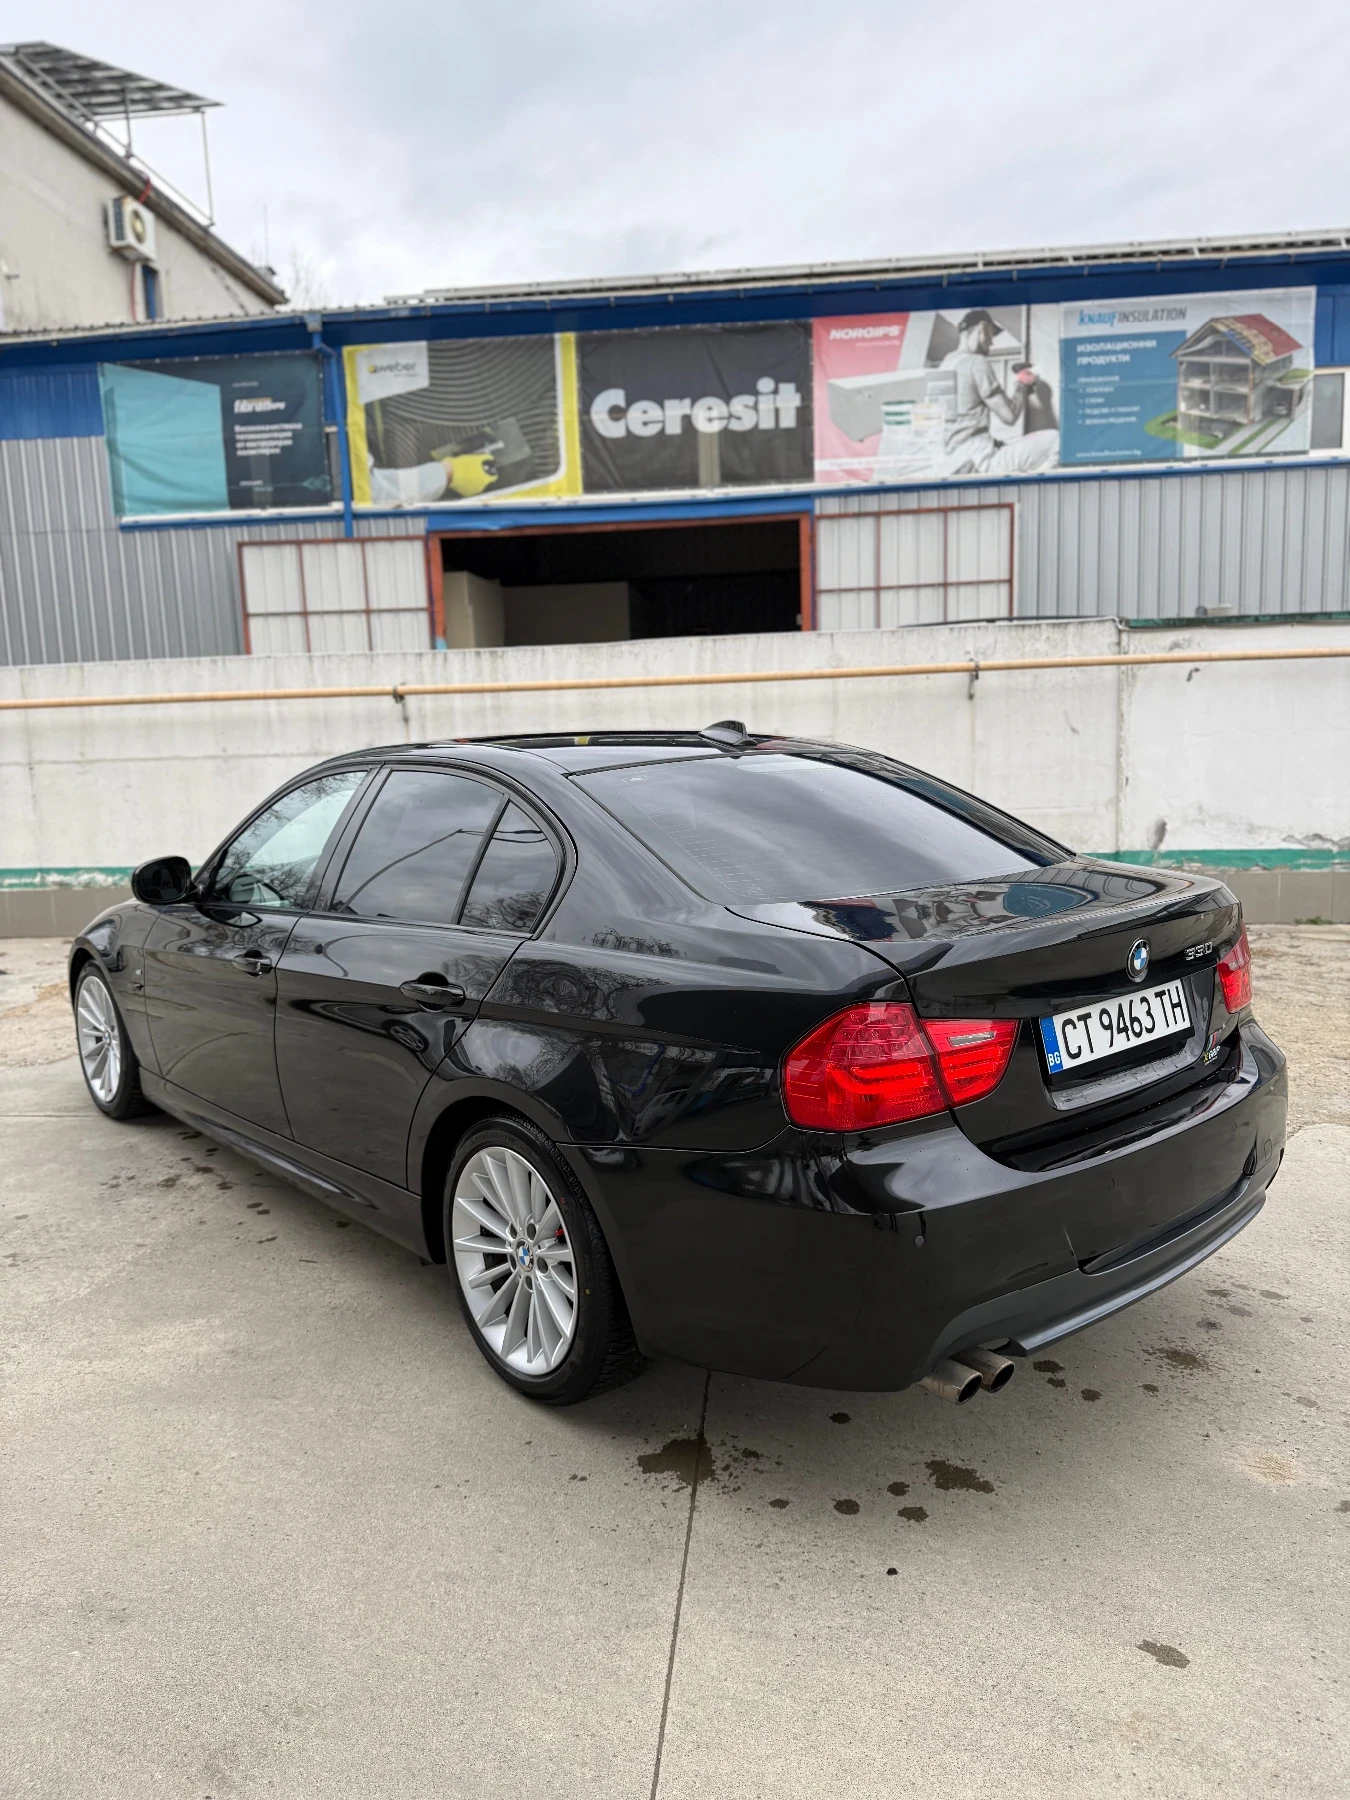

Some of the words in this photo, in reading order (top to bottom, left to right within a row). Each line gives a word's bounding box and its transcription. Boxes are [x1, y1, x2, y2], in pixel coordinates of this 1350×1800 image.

[1117, 306, 1187, 323] INSULATION
[829, 325, 900, 341] NORGIPS
[590, 376, 801, 438] Ceresit
[1184, 941, 1213, 961] 330
[1061, 1011, 1094, 1060] CT
[1098, 996, 1156, 1048] 9463
[1154, 985, 1186, 1028] TH
[1047, 1051, 1061, 1067] BG
